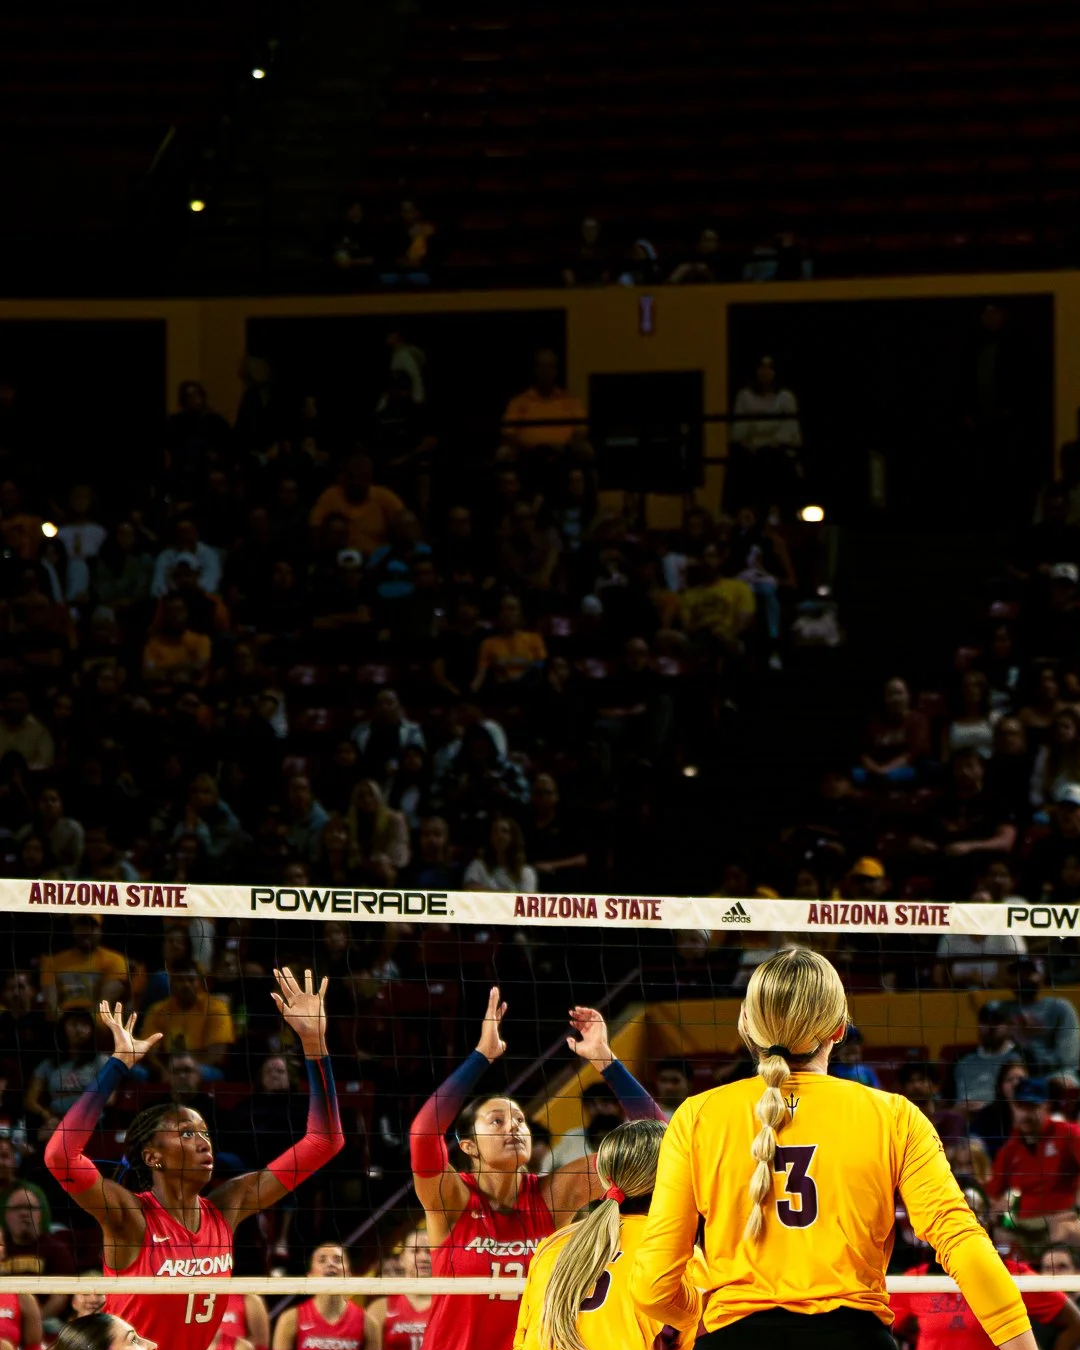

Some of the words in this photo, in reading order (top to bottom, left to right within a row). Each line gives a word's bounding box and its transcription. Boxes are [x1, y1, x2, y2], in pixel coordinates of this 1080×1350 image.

[28, 882, 119, 907] ARIZONA
[126, 884, 188, 908] STATE
[250, 888, 448, 916] POWERADE
[513, 896, 598, 919] ARIZONA
[604, 898, 662, 921] STATE
[721, 914, 752, 924] adidas
[807, 903, 889, 926] ARIZONA
[895, 905, 950, 927] STATE
[773, 1143, 819, 1229] 3
[465, 1236, 547, 1256] ARIZON
[157, 1252, 235, 1277] ARIZONA
[185, 1293, 217, 1324] 13
